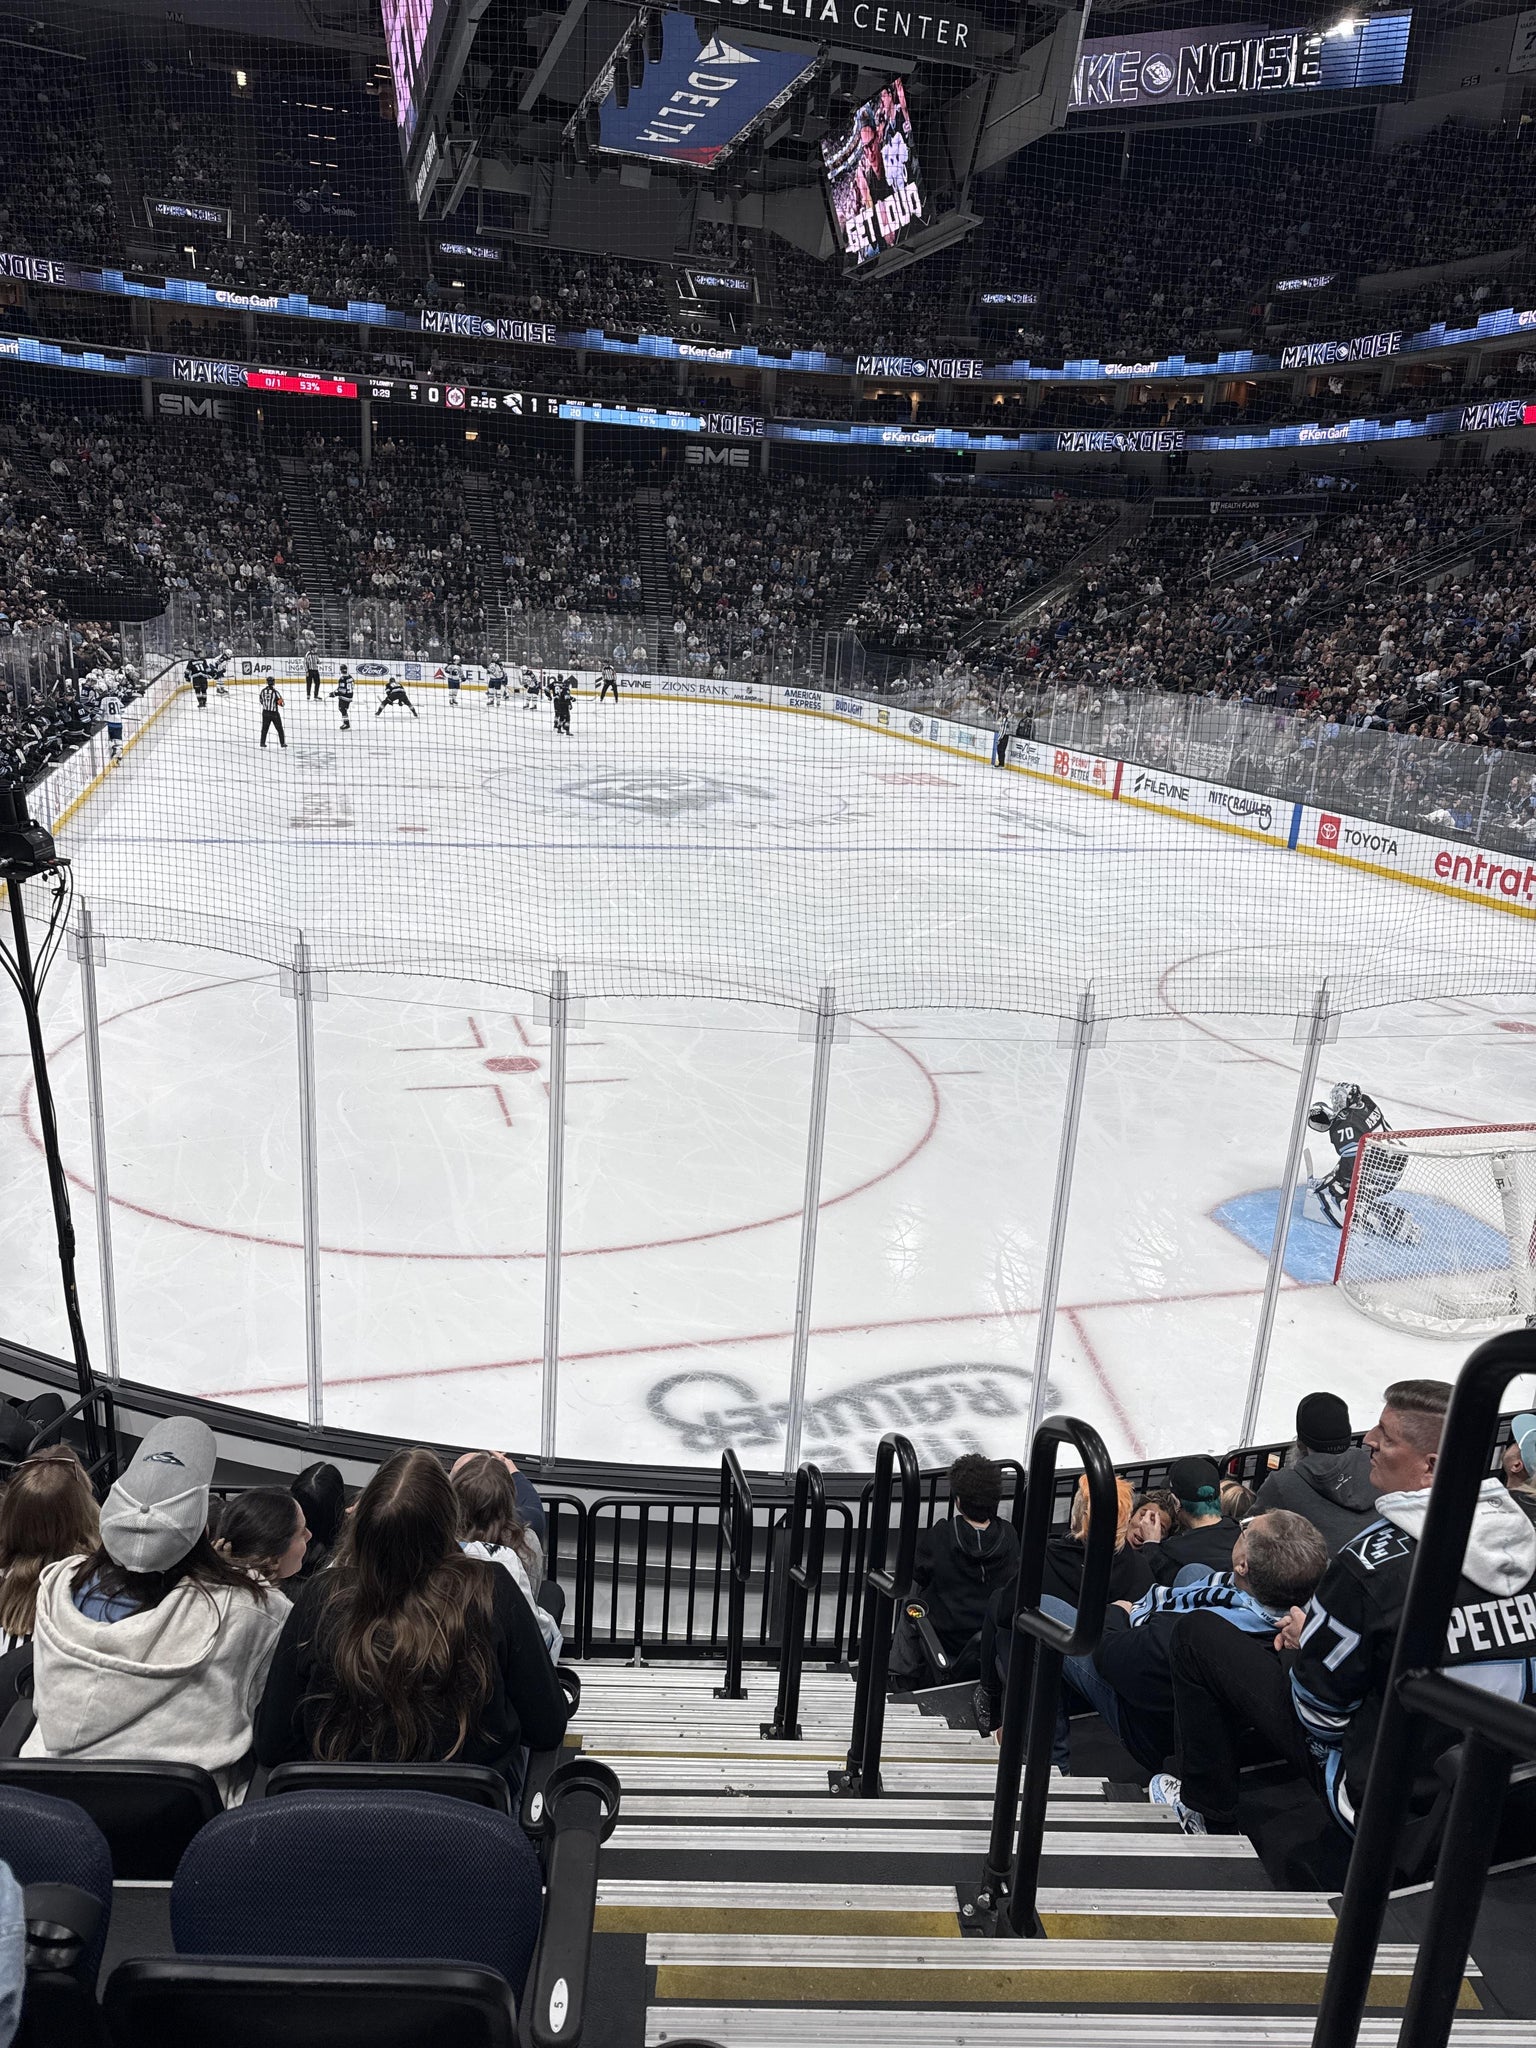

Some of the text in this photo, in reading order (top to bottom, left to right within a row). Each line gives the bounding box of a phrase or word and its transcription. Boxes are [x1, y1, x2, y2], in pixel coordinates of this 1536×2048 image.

[732, 0, 968, 47] LTA CENTER
[1069, 34, 1322, 106] KE NOISE
[636, 71, 732, 143] DELTA
[845, 182, 922, 253] GET LOUD
[227, 291, 278, 308] Ken Garff
[421, 309, 556, 344] MAKE NOISE
[0, 343, 18, 354] arff
[688, 345, 732, 360] Ken Garff
[1281, 331, 1402, 369] MAKE NOISE
[173, 358, 240, 386] MAKE
[856, 355, 984, 379] MAKE NOISE
[1113, 362, 1158, 374] Ken Garff
[265, 378, 281, 387] 0/1
[300, 382, 320, 391] 53%
[336, 385, 342, 393] 6
[373, 389, 390, 398] 0:29
[411, 391, 416, 399] 5
[428, 388, 438, 402] 0
[159, 393, 234, 420] SME
[470, 396, 497, 409] 2:26
[531, 398, 537, 412] 1
[548, 405, 558, 414] 12
[570, 409, 581, 417] 20
[1460, 400, 1520, 431] MAKE
[671, 418, 685, 427] 0/1
[708, 413, 765, 437] NOISE
[891, 431, 935, 443] Ken Garff
[1057, 430, 1185, 451] MAKE NOISE
[1308, 426, 1349, 441] Ken Garff
[685, 445, 749, 467] SME
[363, 663, 383, 676] Ford
[617, 679, 651, 689] EVINE
[662, 681, 728, 696] ZIONS BANK
[784, 689, 822, 700] AMERICAN
[108, 701, 120, 715] 81
[789, 698, 822, 710] EXPRESS
[836, 700, 863, 716] BUD LIGHT
[1071, 769, 1089, 781] BETTER
[1144, 778, 1189, 801] FILEVINE
[1345, 829, 1398, 856] TOYOTA
[1434, 851, 1536, 901] entrat
[1337, 1126, 1354, 1142] 70
[1260, 1611, 1275, 1625] TAH
[1447, 1592, 1536, 1654] PETER
[554, 2001, 564, 2009] 5
